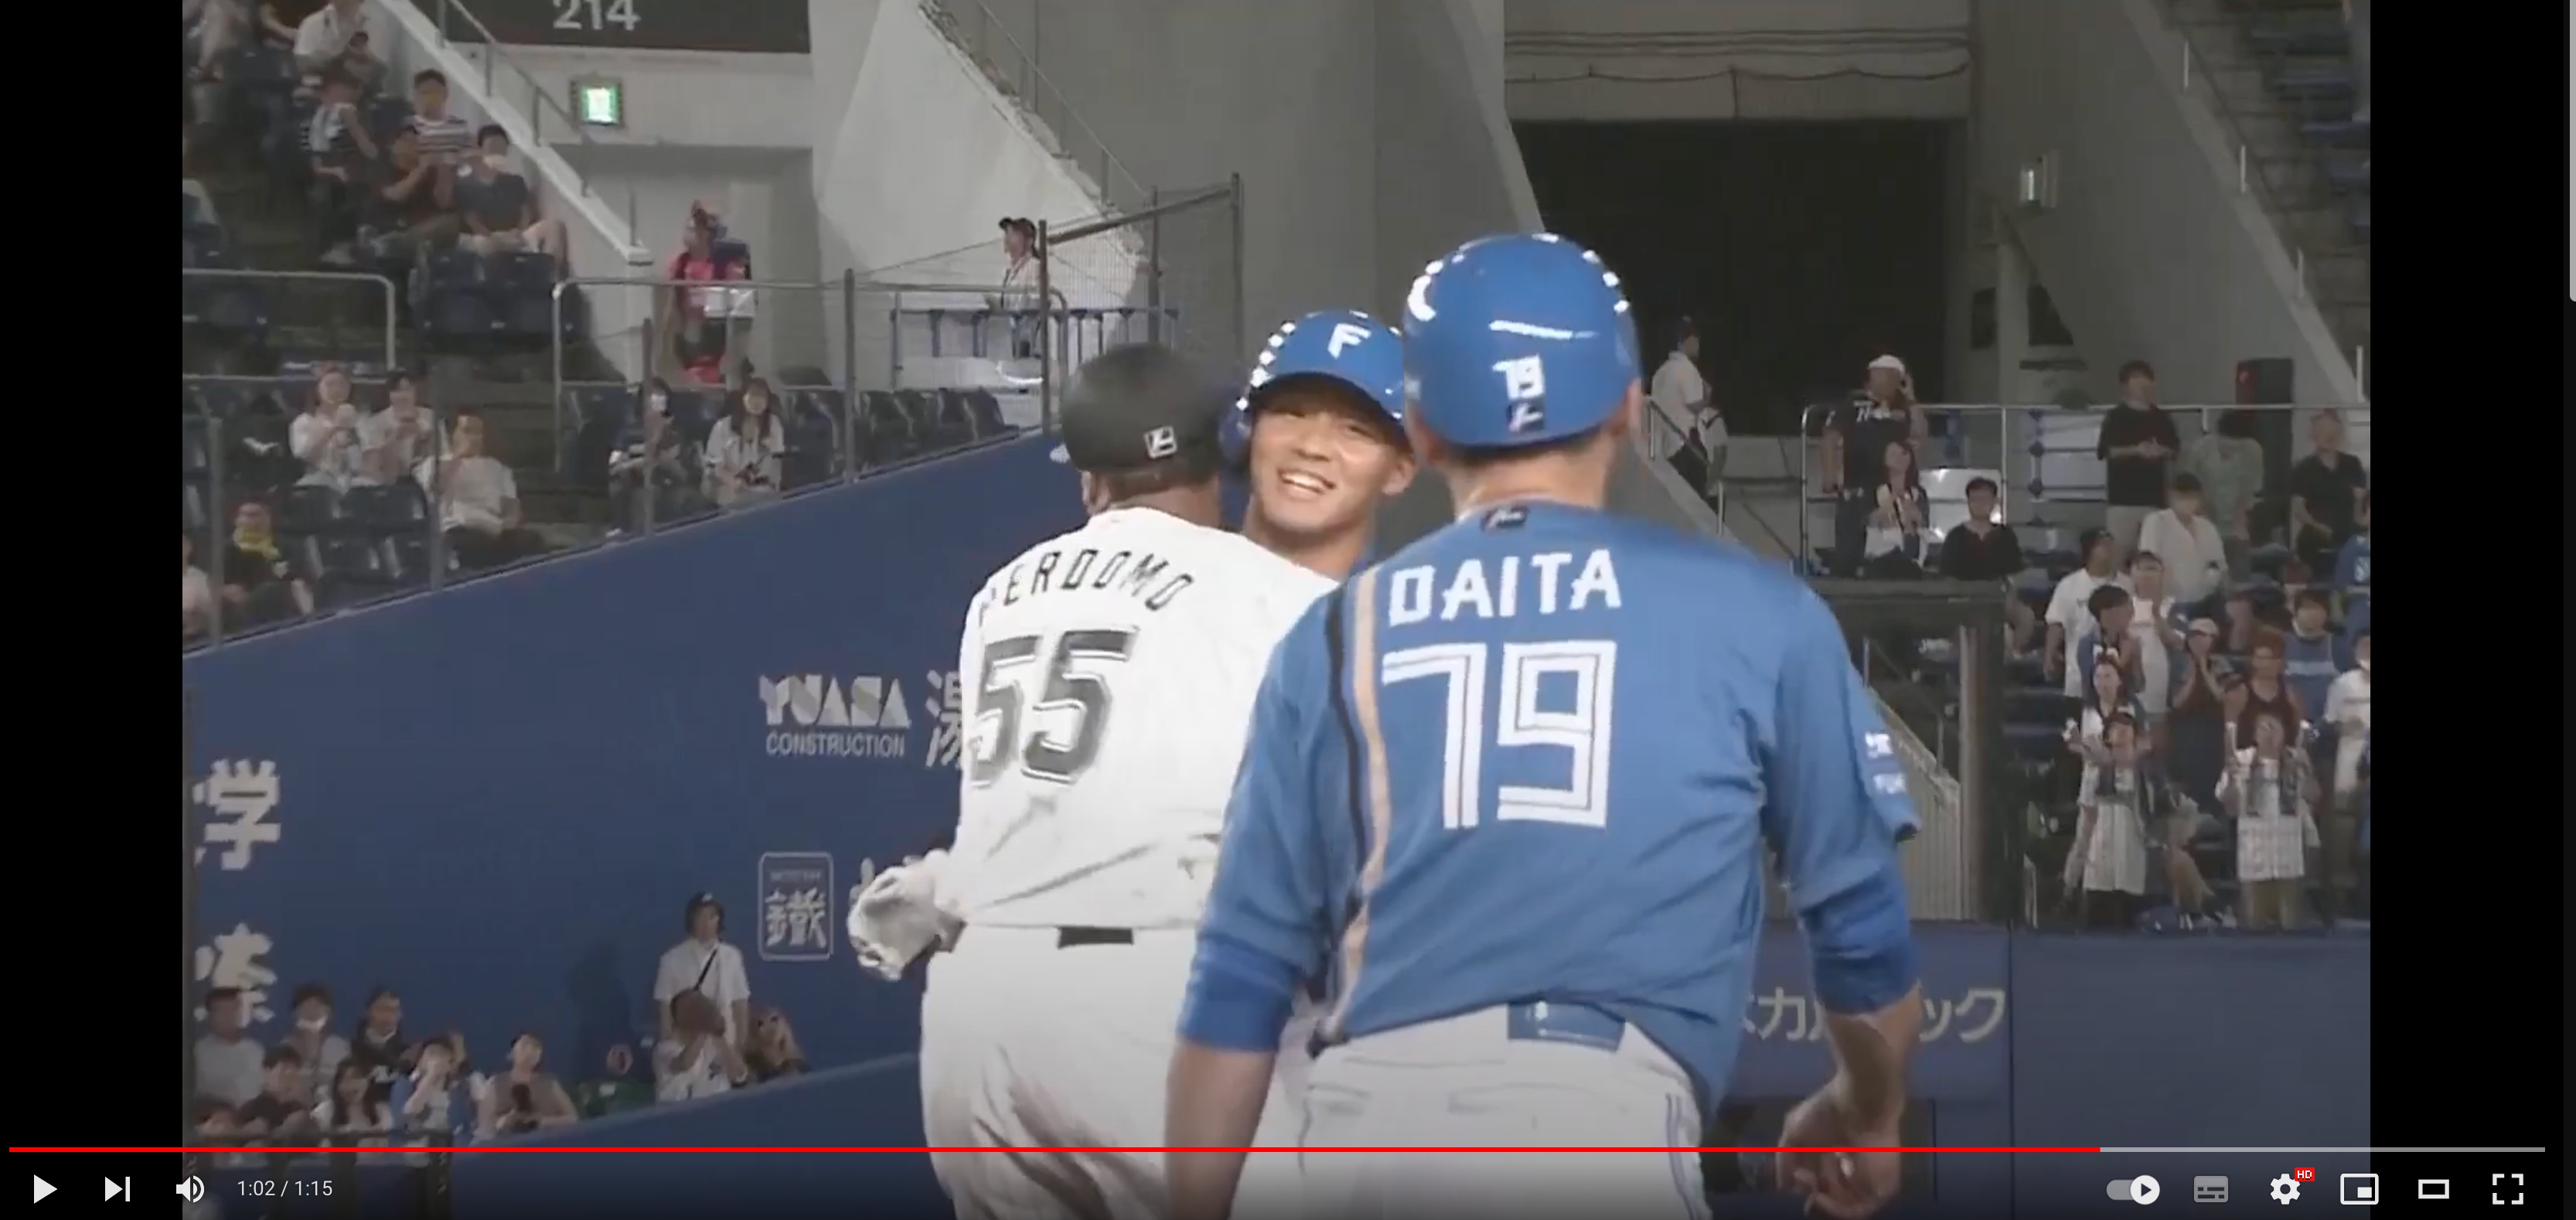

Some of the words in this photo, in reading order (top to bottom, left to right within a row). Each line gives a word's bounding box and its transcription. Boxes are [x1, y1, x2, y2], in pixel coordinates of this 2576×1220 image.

[553, 0, 641, 31] 214
[1327, 322, 1372, 360] F
[1492, 353, 1545, 401] 79
[1389, 549, 1622, 628] DAITA
[758, 673, 911, 728] YUASA
[970, 625, 1140, 787] 55
[765, 731, 905, 758] CONSTRUCTION
[1382, 639, 1617, 830] 79
[193, 758, 281, 871] 学
